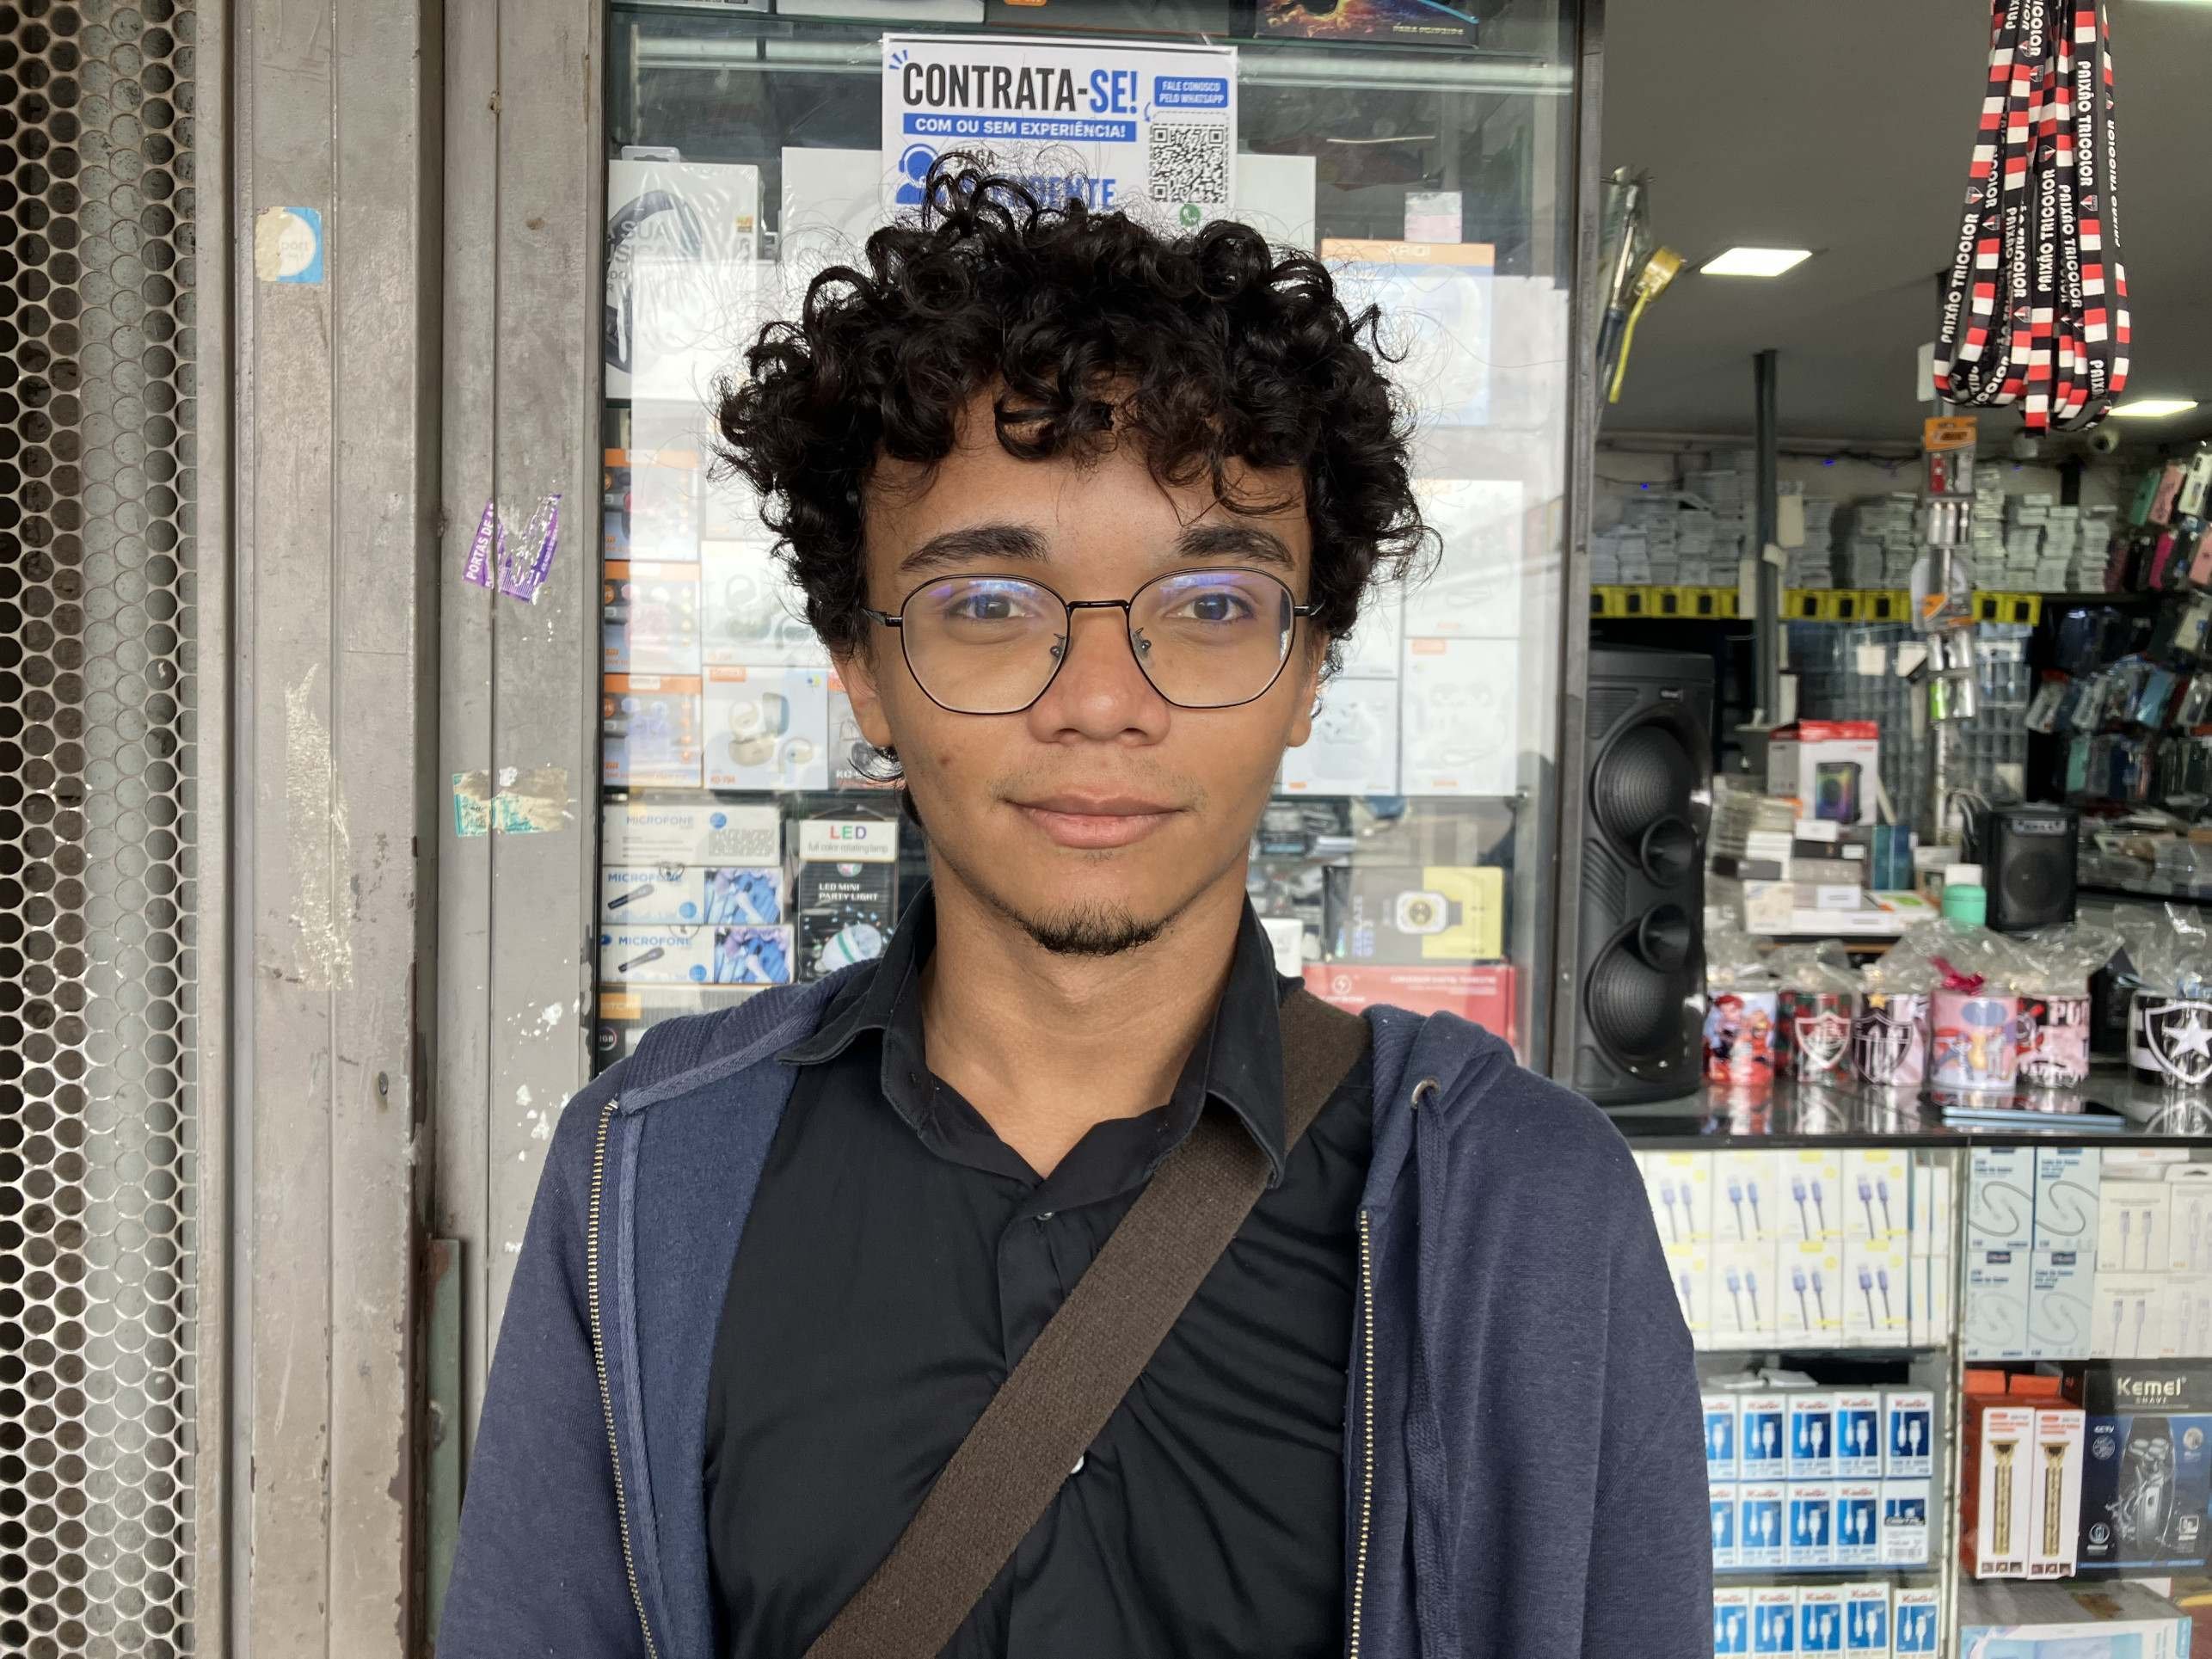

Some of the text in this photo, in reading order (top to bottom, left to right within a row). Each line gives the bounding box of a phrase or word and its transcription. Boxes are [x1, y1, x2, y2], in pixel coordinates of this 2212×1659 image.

[903, 62, 1139, 114] CONTRATA-SE!
[1162, 81, 1221, 92] FALE CONOSCO
[1159, 93, 1225, 103] PELO WHATSAPP
[915, 118, 1127, 138] COM OU SEM EXPERIÊNCIA!
[465, 536, 488, 581] PORTAS
[830, 826, 867, 840] LED
[819, 882, 860, 891] LED MINI
[819, 892, 879, 902] PARTY LIGHT
